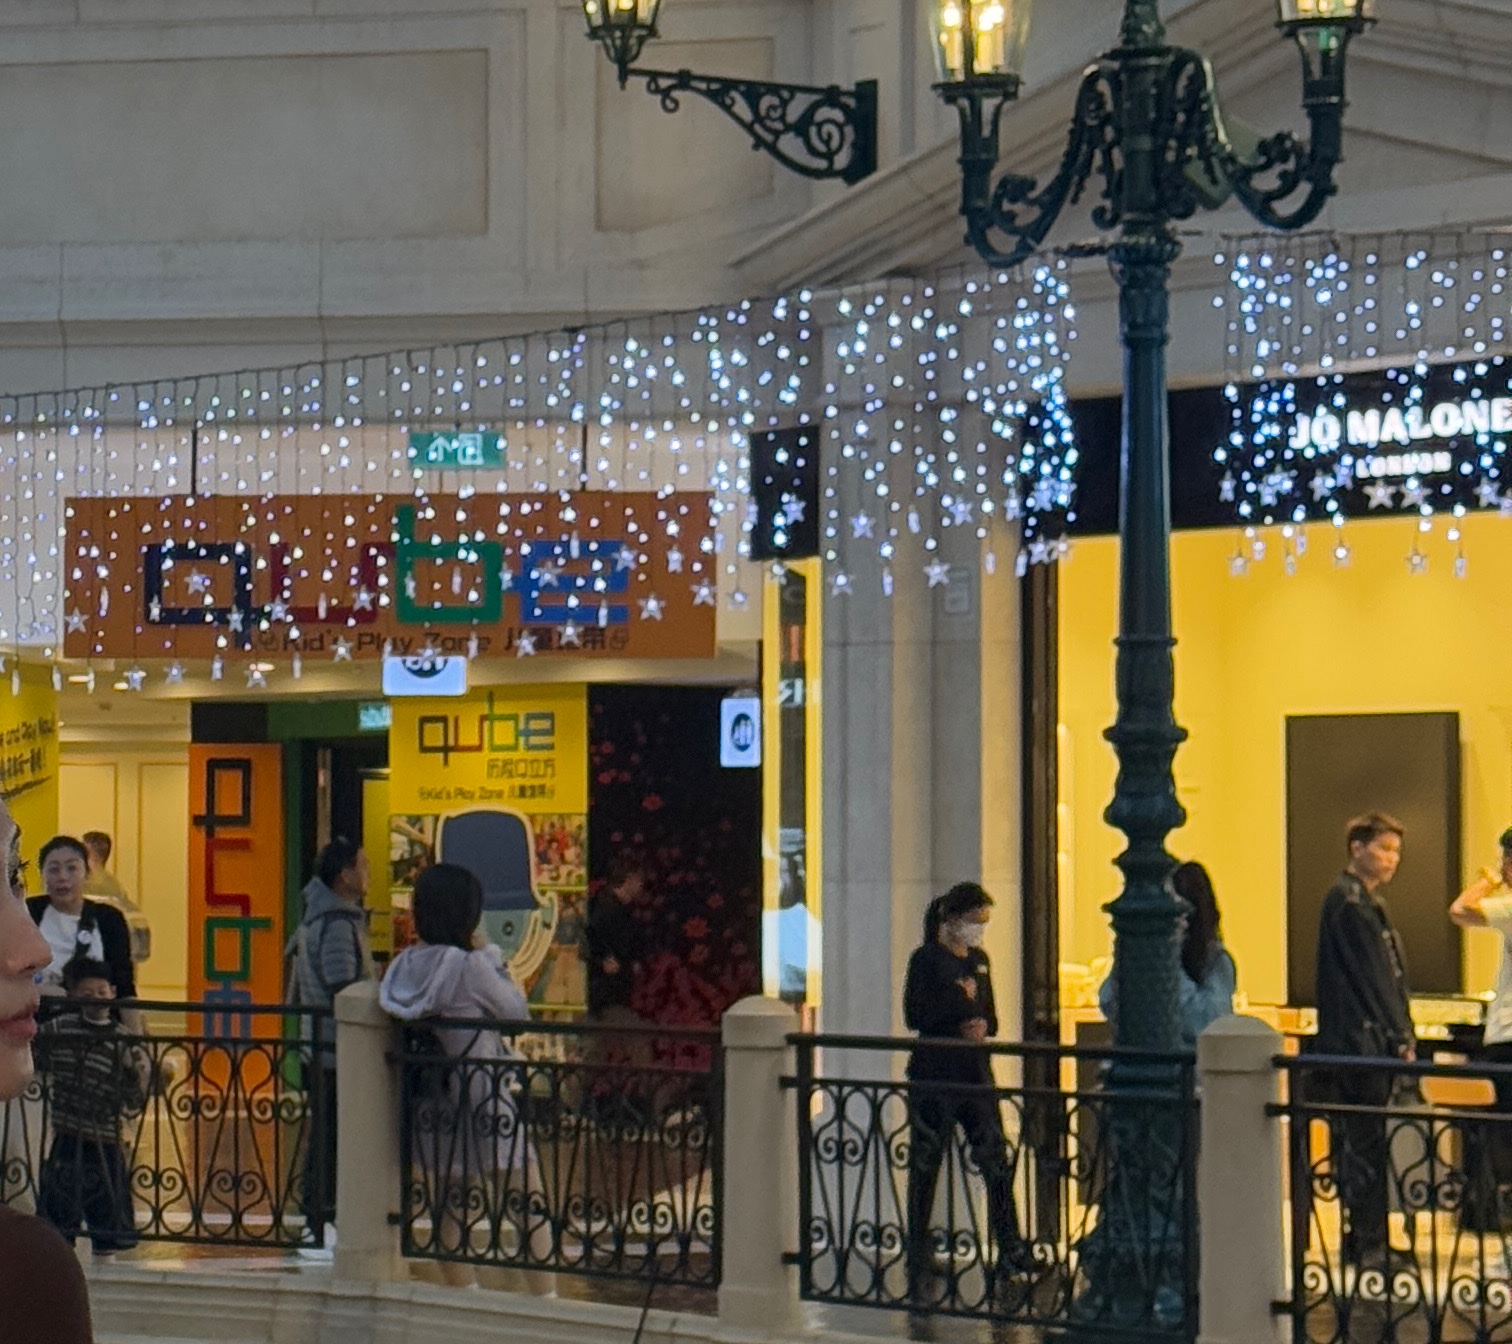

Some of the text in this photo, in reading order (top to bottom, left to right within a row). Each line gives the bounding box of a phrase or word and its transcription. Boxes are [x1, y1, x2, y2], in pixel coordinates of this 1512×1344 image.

[1289, 398, 1512, 450] JO MALONE
[1356, 452, 1451, 478] LONDON
